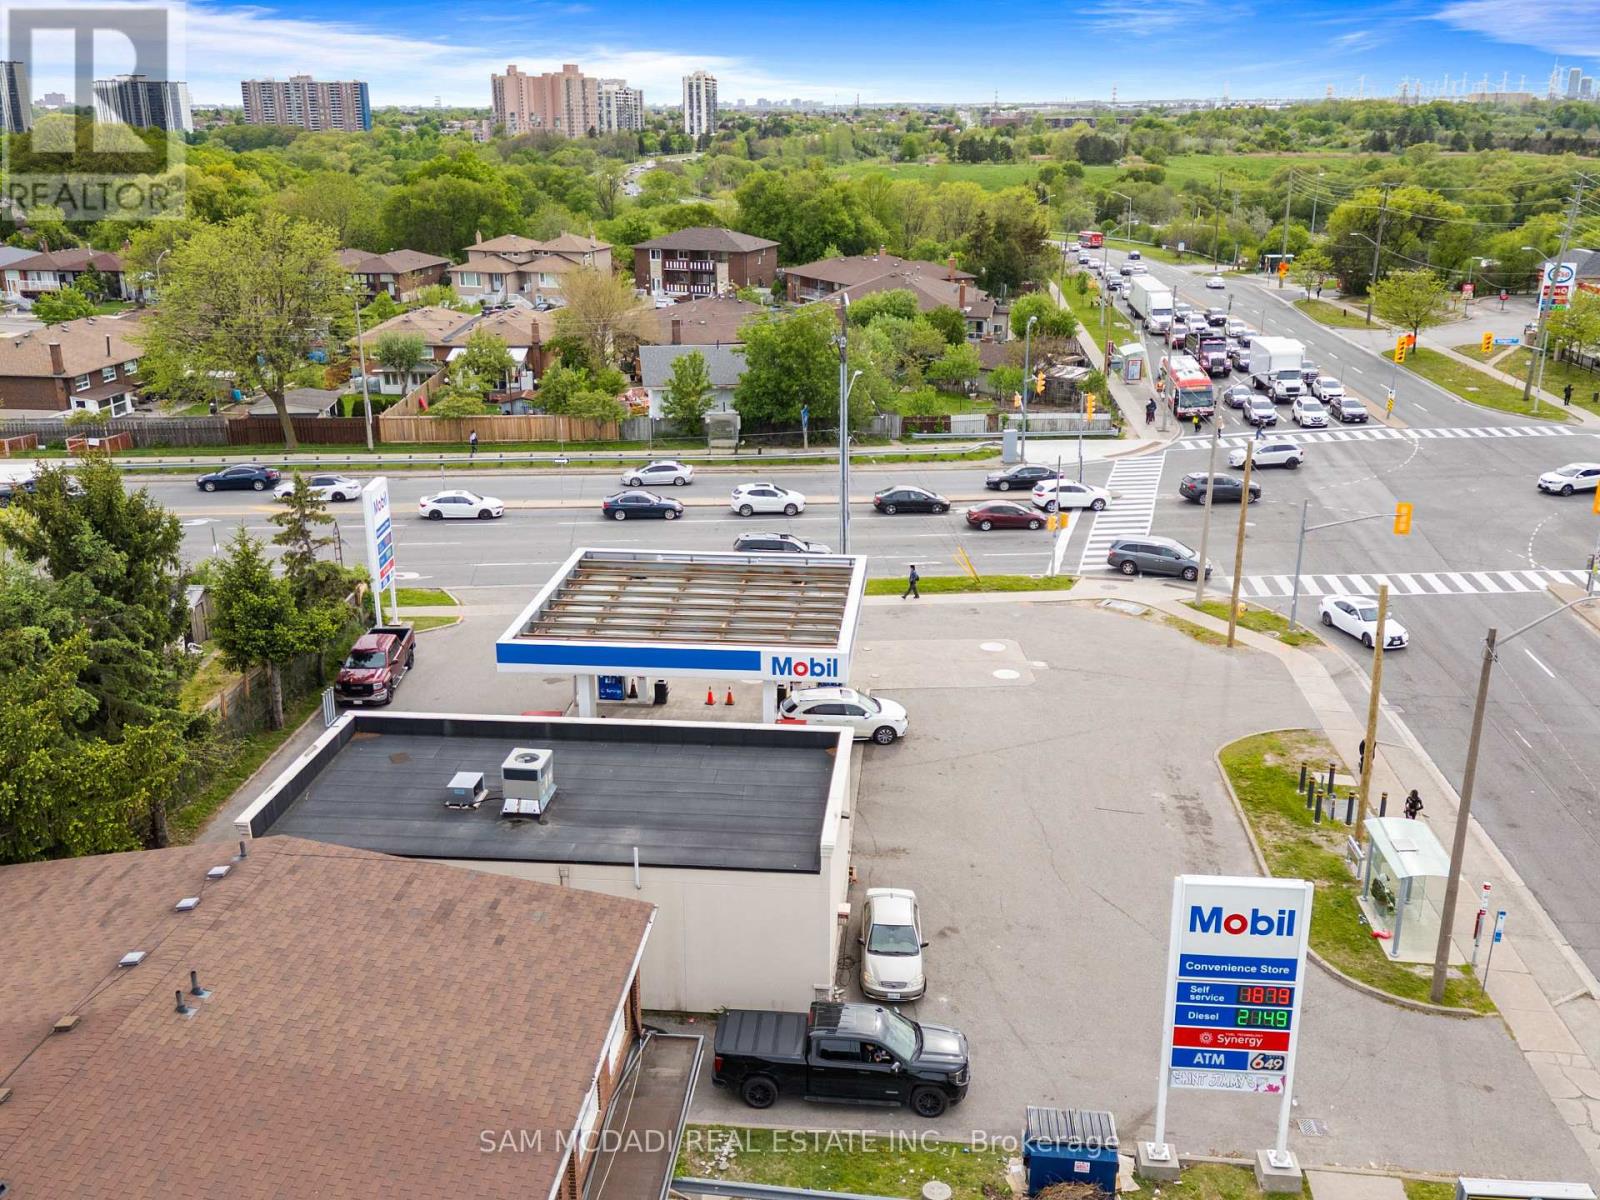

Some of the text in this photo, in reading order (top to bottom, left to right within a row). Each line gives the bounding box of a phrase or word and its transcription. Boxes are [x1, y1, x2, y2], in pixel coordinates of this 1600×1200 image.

[771, 656, 838, 677] Mobil
[1189, 905, 1296, 937] Mobil
[1185, 961, 1290, 974] Convenience Store
[1190, 985, 1210, 993] Self
[1189, 994, 1225, 1002] service
[1188, 1011, 1219, 1020] Diesel
[1217, 1034, 1263, 1047] Synergy
[1193, 1053, 1225, 1065] ATM
